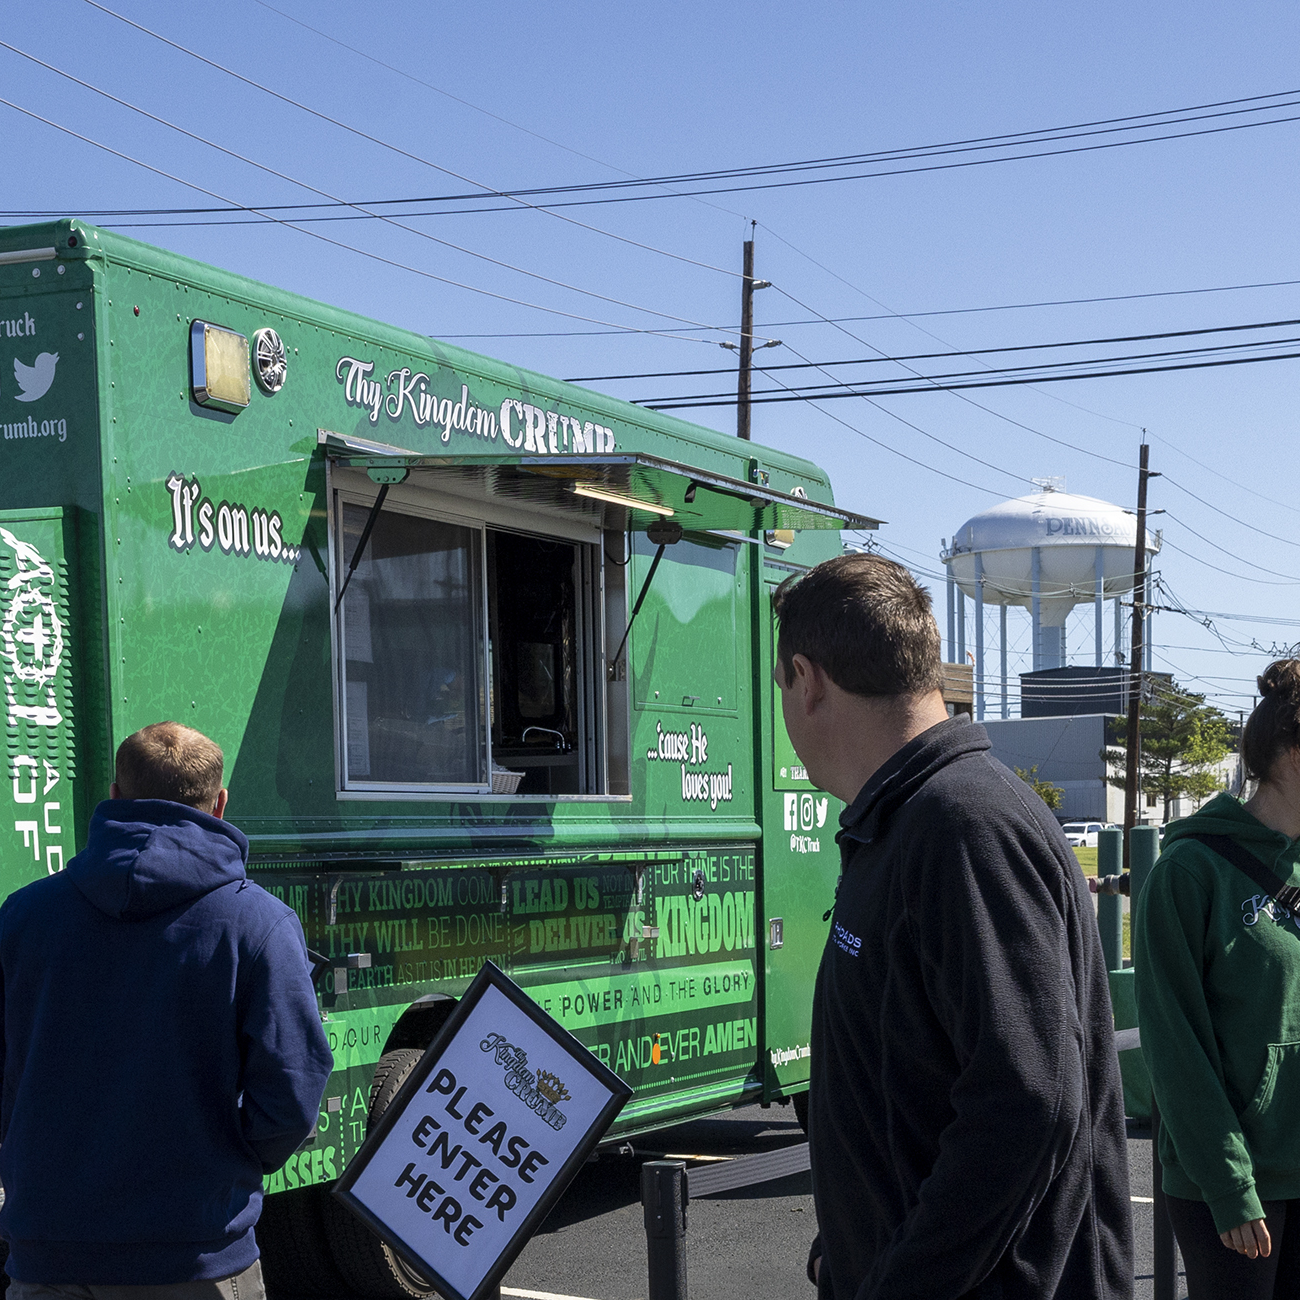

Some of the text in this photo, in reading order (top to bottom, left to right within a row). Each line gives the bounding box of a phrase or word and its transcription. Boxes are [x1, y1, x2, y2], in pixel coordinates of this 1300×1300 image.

[336, 356, 384, 422] Thy
[385, 367, 499, 442] Kingdom
[167, 476, 301, 560] It's on us...
[690, 724, 708, 764] He
[13, 755, 41, 861] OF
[681, 763, 732, 810] loves you!
[325, 880, 364, 914] HY
[368, 877, 453, 911] KINGDOM
[512, 877, 569, 915] LEAD
[573, 875, 600, 910] US
[684, 857, 718, 884] THINE
[720, 856, 731, 882] IS
[732, 855, 755, 881] THE
[325, 922, 369, 959] THY
[374, 918, 424, 954] WILL
[427, 916, 451, 950] BE
[455, 913, 505, 948] DONE
[529, 913, 618, 954] DELIVER
[655, 891, 756, 959] KINGDOM
[349, 965, 394, 989] EARTH
[398, 963, 414, 985] AS
[416, 961, 428, 985] IT
[430, 959, 442, 982] IS
[443, 957, 457, 980] IN
[562, 989, 623, 1018] POWER
[631, 984, 662, 1007] AND
[669, 979, 696, 999] THE
[703, 974, 750, 996] GLORY
[480, 1032, 536, 1085] Kingdom
[615, 1037, 654, 1074] AND
[657, 1027, 701, 1065] EVER
[703, 1017, 757, 1056] AMEN
[426, 1068, 550, 1184] PLEASE
[504, 1070, 568, 1132] CRUMB
[411, 1115, 517, 1223] ENTER
[394, 1162, 485, 1247] HERE
